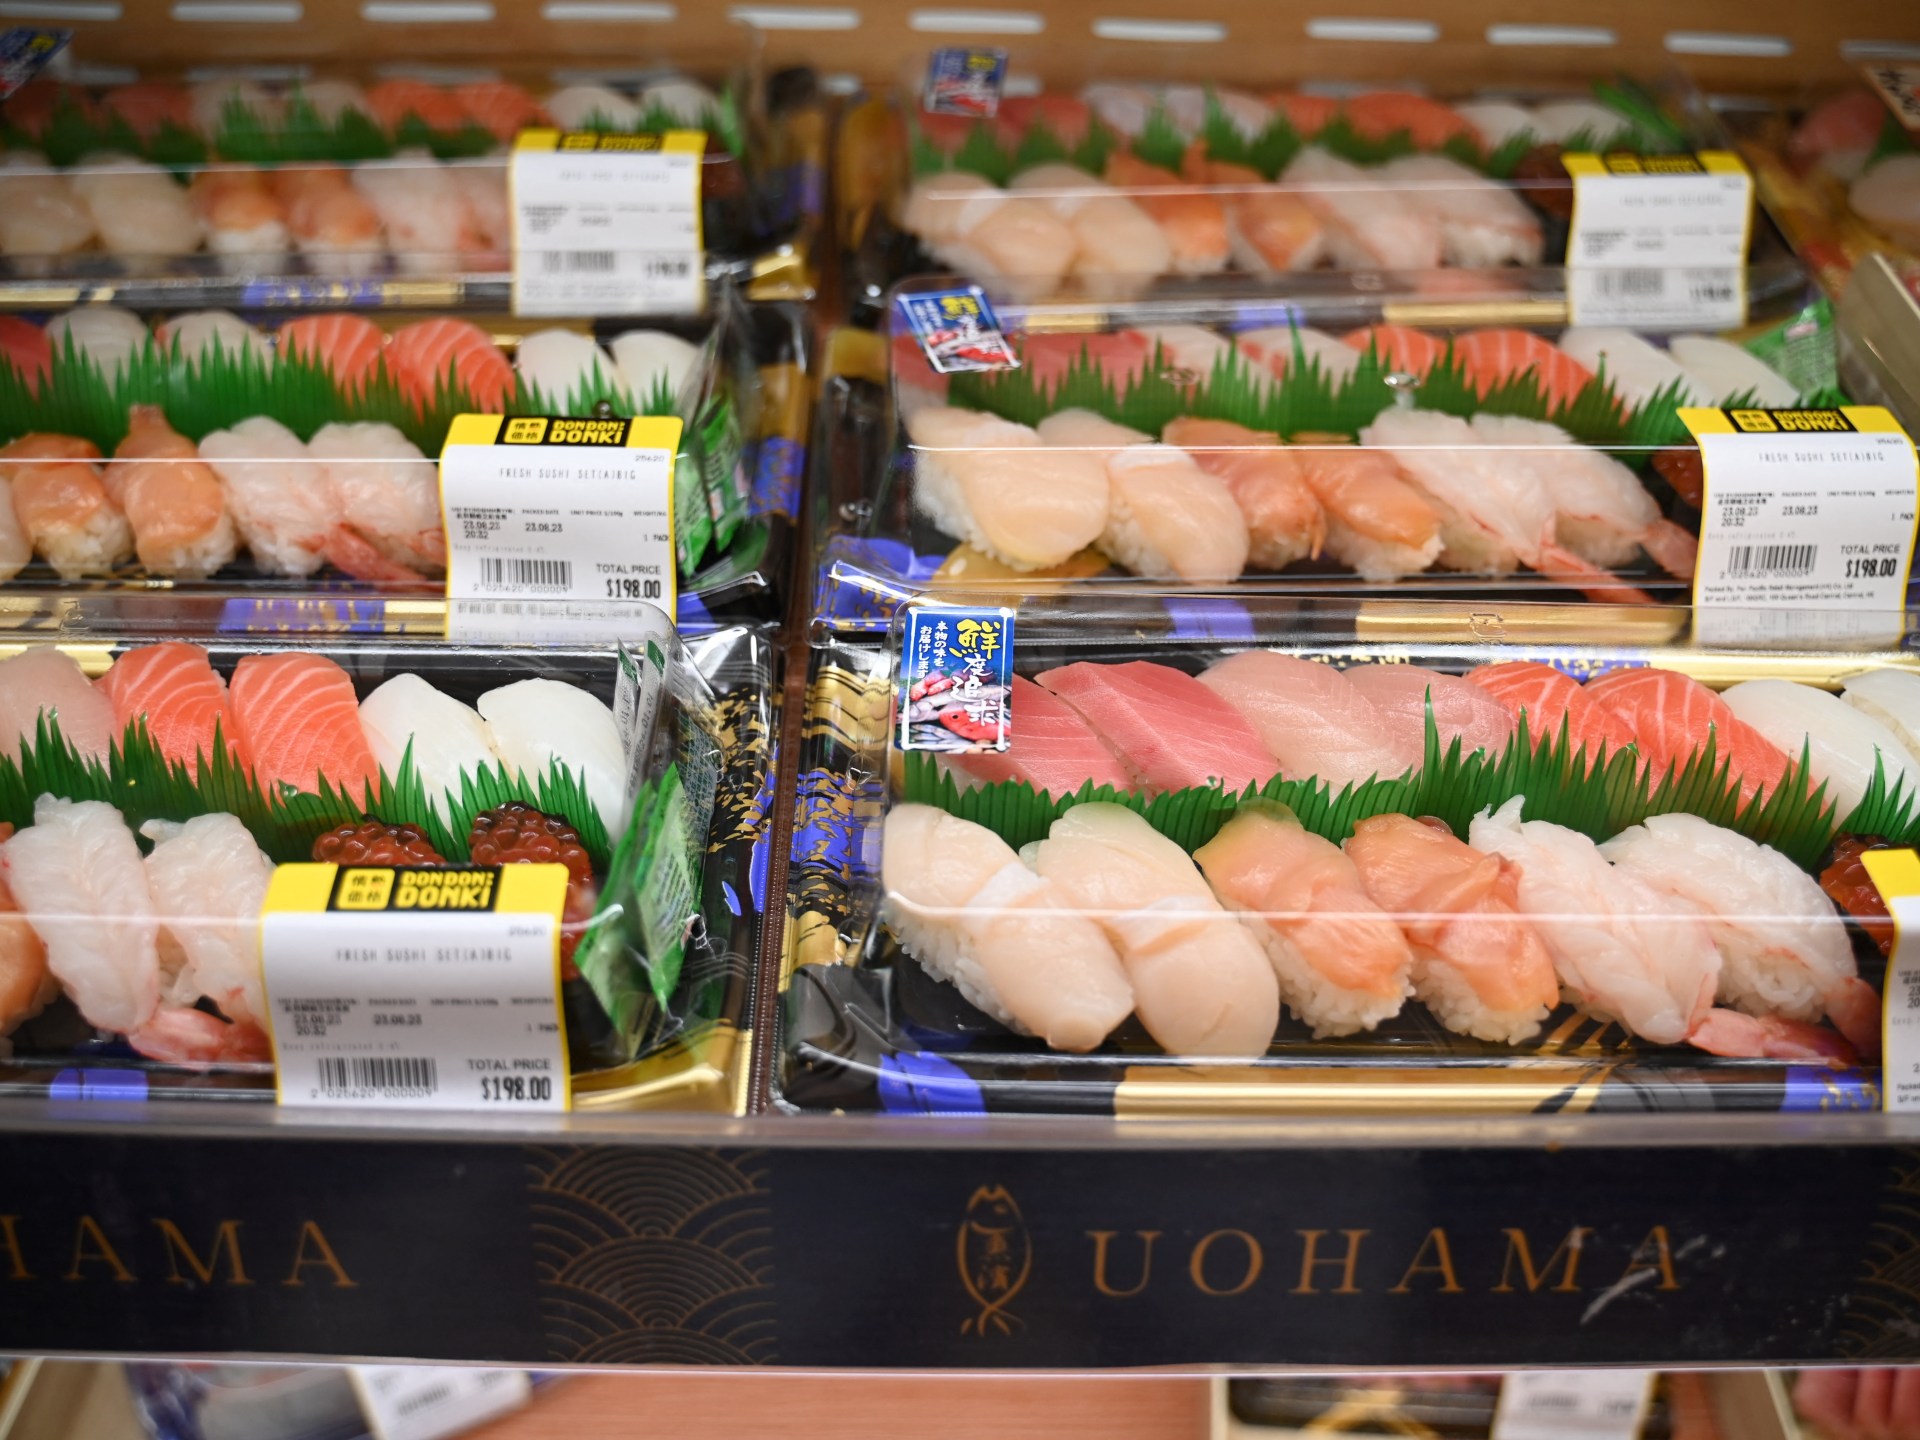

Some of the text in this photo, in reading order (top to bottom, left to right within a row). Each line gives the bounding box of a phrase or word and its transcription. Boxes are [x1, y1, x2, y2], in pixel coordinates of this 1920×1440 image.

[550, 430, 622, 444] DONKI
[500, 468, 531, 478] FRESH
[539, 469, 569, 479] SUSHI
[1841, 543, 1900, 554] TOTAL PRICE
[597, 564, 661, 575] TOTAL PRICE
[1846, 558, 1897, 578] $198.00
[606, 578, 661, 599] $198.00
[917, 625, 932, 679] お届けします
[933, 621, 948, 667] 本物の味を
[396, 886, 490, 908] DONKI
[467, 1059, 552, 1071] TOTAL PRICE
[311, 1088, 318, 1098] 2
[482, 1076, 552, 1101] $198.00
[1085, 1225, 1683, 1297] UOHAMA
